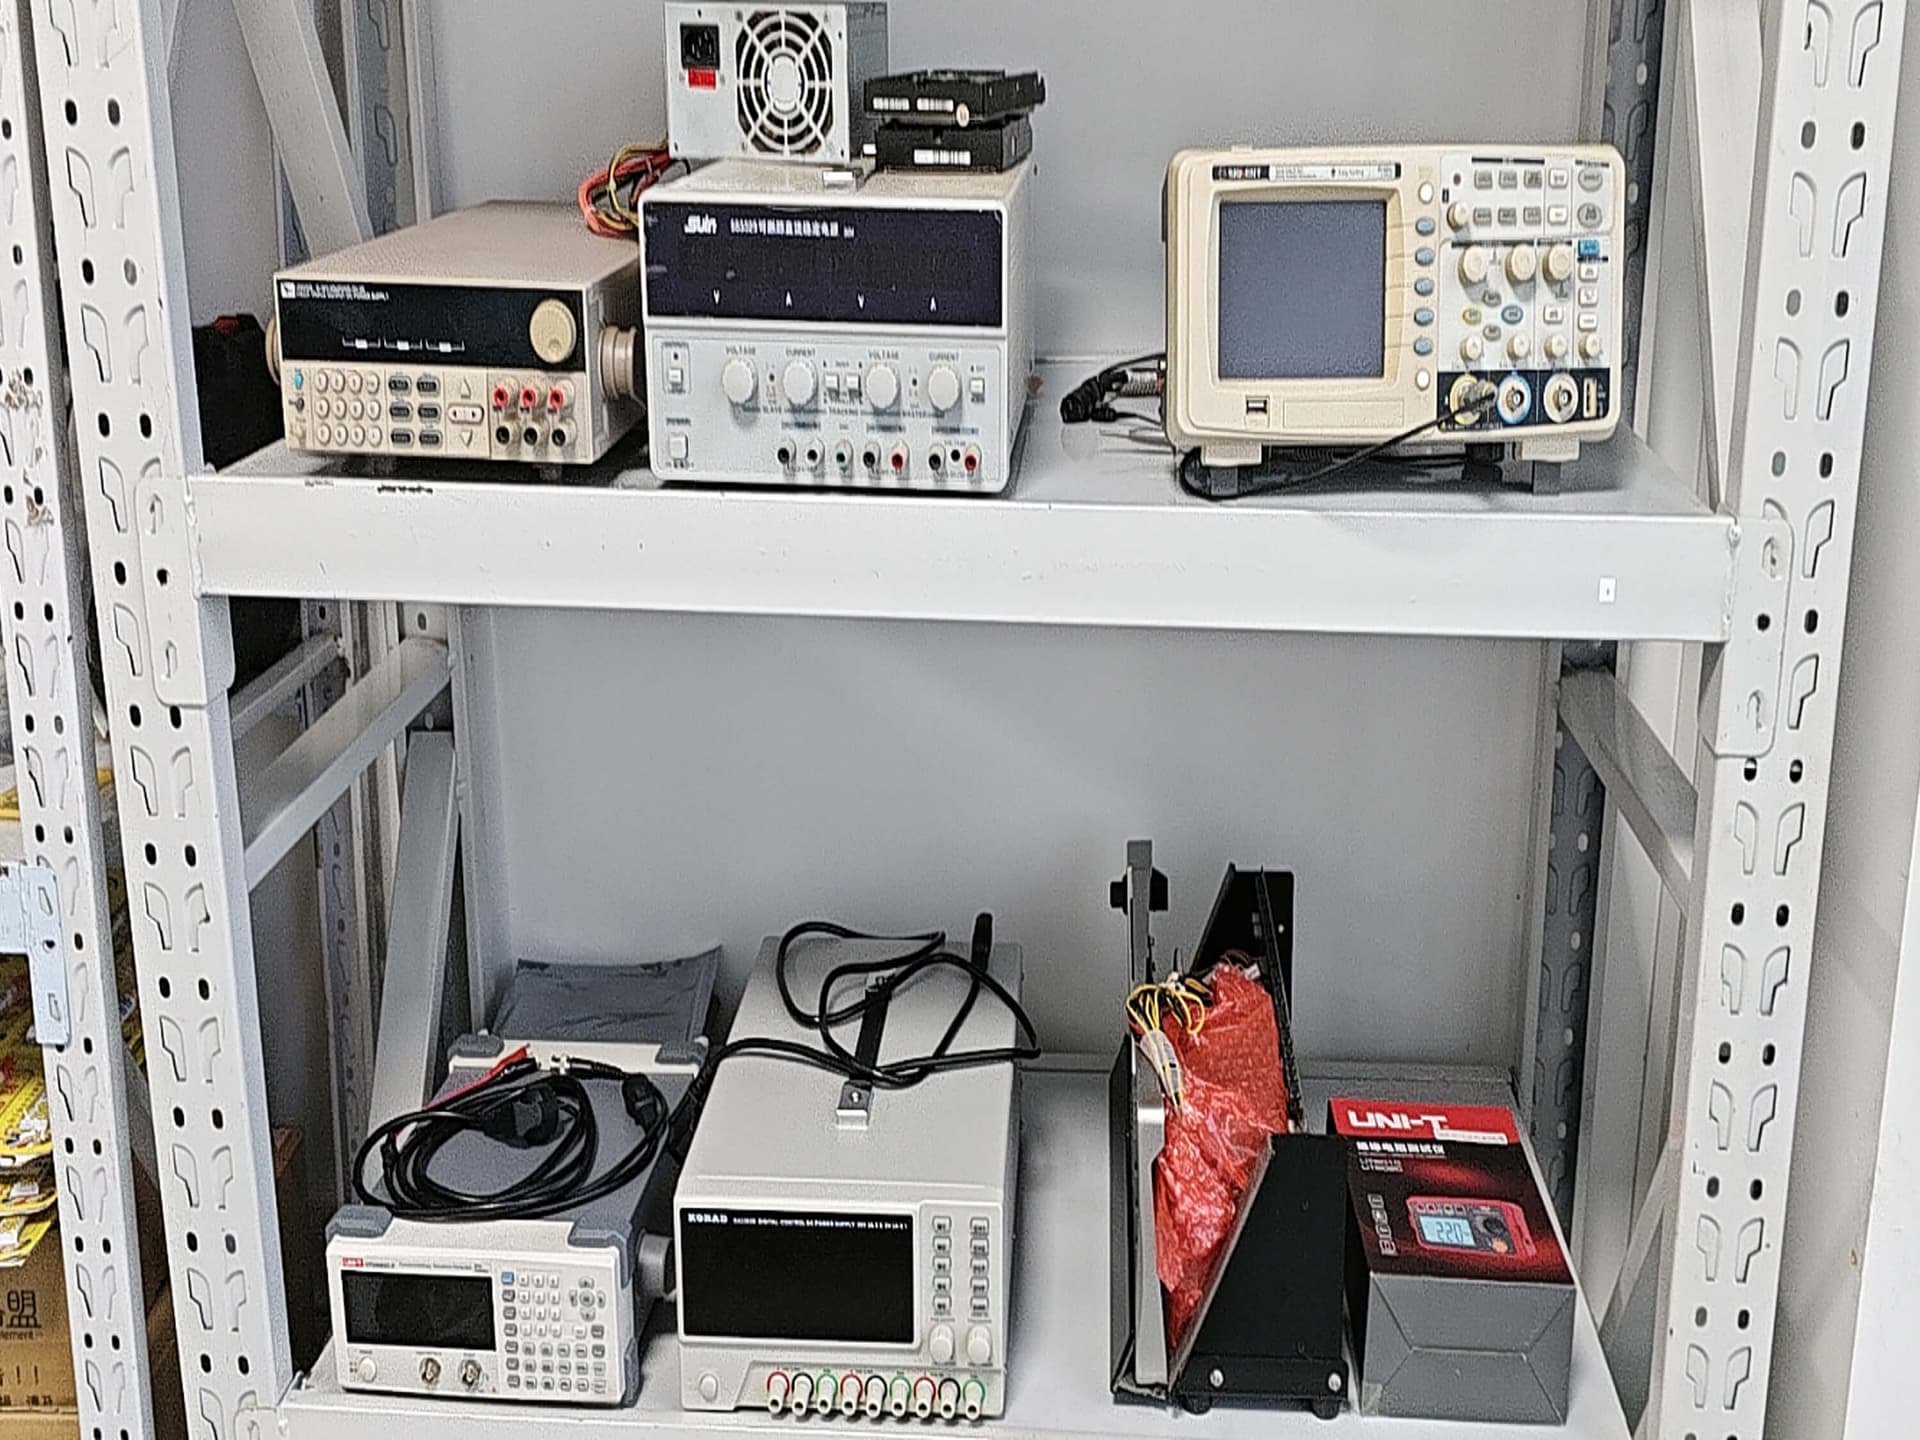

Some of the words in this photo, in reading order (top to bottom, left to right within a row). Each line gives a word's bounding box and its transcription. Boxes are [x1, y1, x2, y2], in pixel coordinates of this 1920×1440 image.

[713, 288, 721, 305] V
[785, 290, 793, 307] A
[857, 294, 865, 310] V
[929, 295, 937, 312] A
[726, 346, 756, 356] VOLTAGE
[785, 348, 816, 357] CURRENT
[868, 350, 899, 360] VOLTAGE
[928, 352, 959, 361] CURRENT
[1347, 1109, 1448, 1140] UNI-T
[687, 1213, 728, 1224] KORAD
[1436, 1221, 1464, 1243] 220
